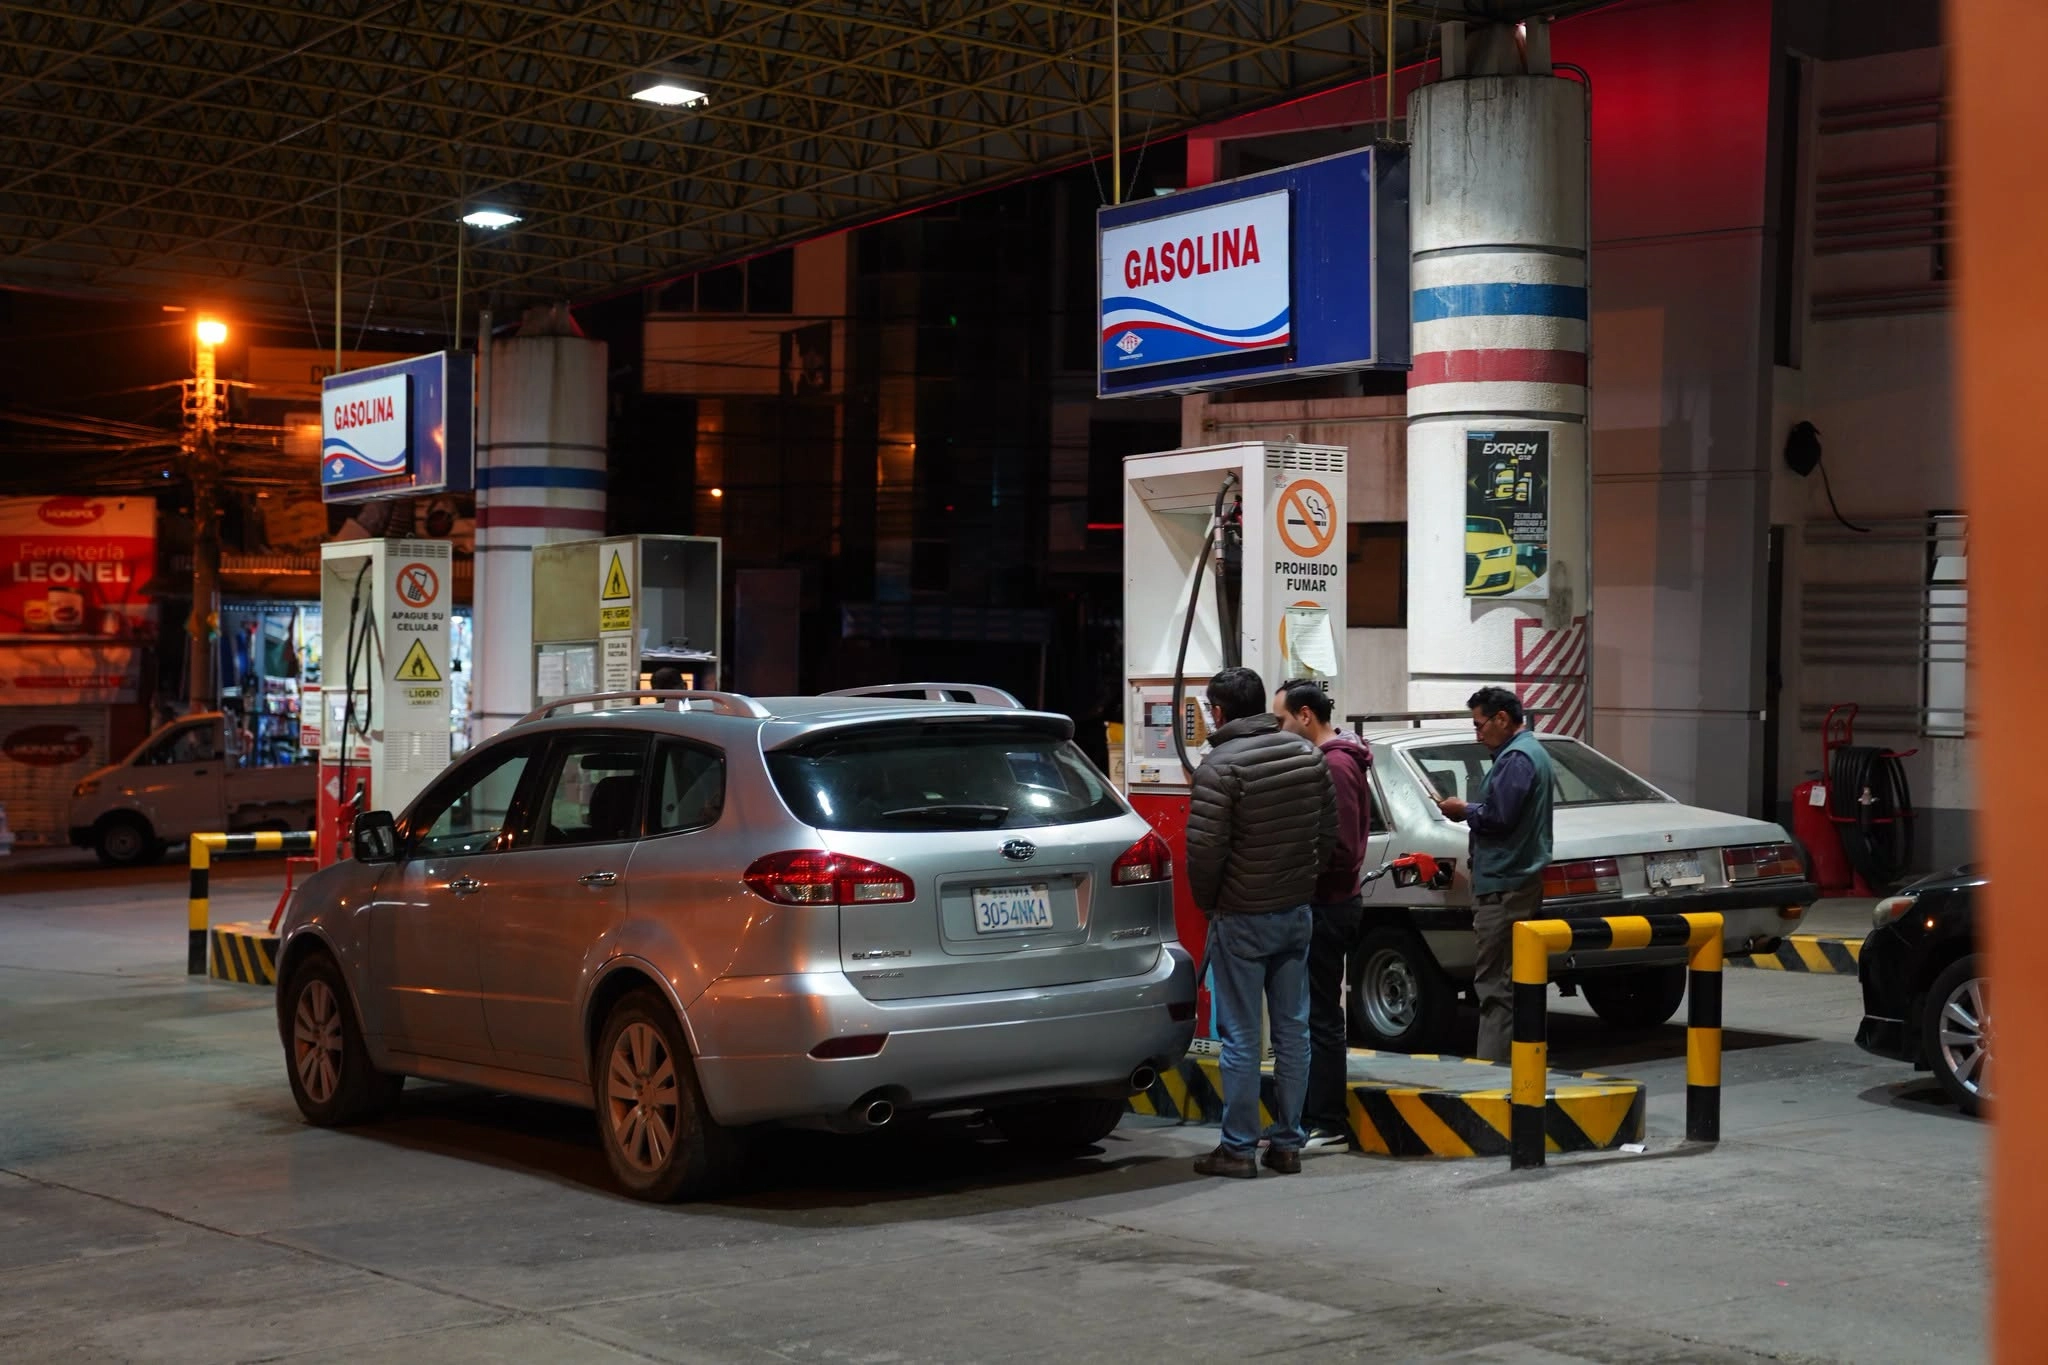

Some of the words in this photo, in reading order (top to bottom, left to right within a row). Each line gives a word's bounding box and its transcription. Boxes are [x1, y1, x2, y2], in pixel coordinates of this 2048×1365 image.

[1124, 225, 1260, 289] GASOLINA
[334, 395, 394, 431] GASOLINA
[1482, 442, 1538, 456] EXTREM
[20, 541, 124, 560] Ferretería
[13, 562, 130, 583] LEONEL
[1275, 561, 1338, 577] PROHIBIDO
[1287, 578, 1326, 592] FUMAR
[392, 612, 429, 620] APAGUE
[432, 612, 444, 620] SU
[397, 623, 439, 631] CELULAR
[980, 899, 1047, 926] 3054NKA
